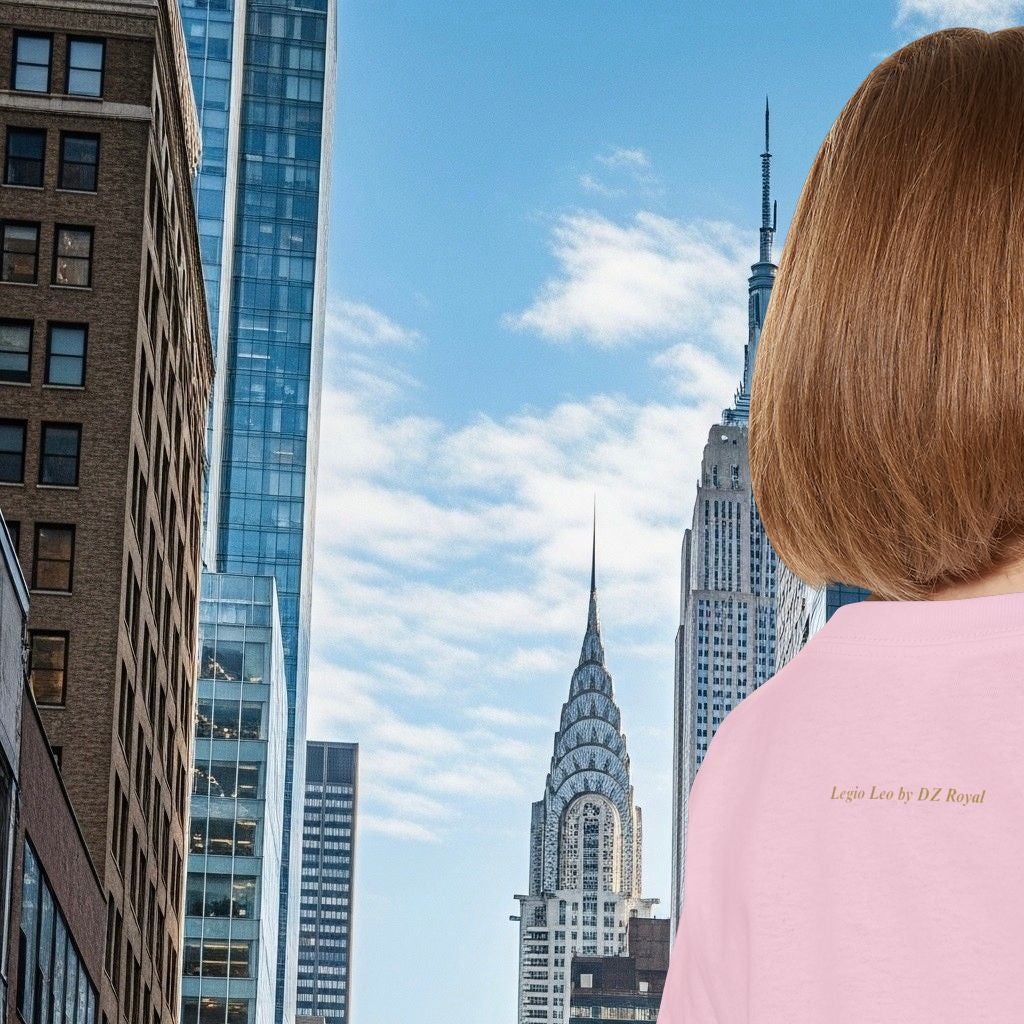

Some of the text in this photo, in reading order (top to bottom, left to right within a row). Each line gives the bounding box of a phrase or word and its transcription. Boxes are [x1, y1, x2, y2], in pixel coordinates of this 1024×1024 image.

[830, 786, 987, 806] Legio Leo by DZ Royal
